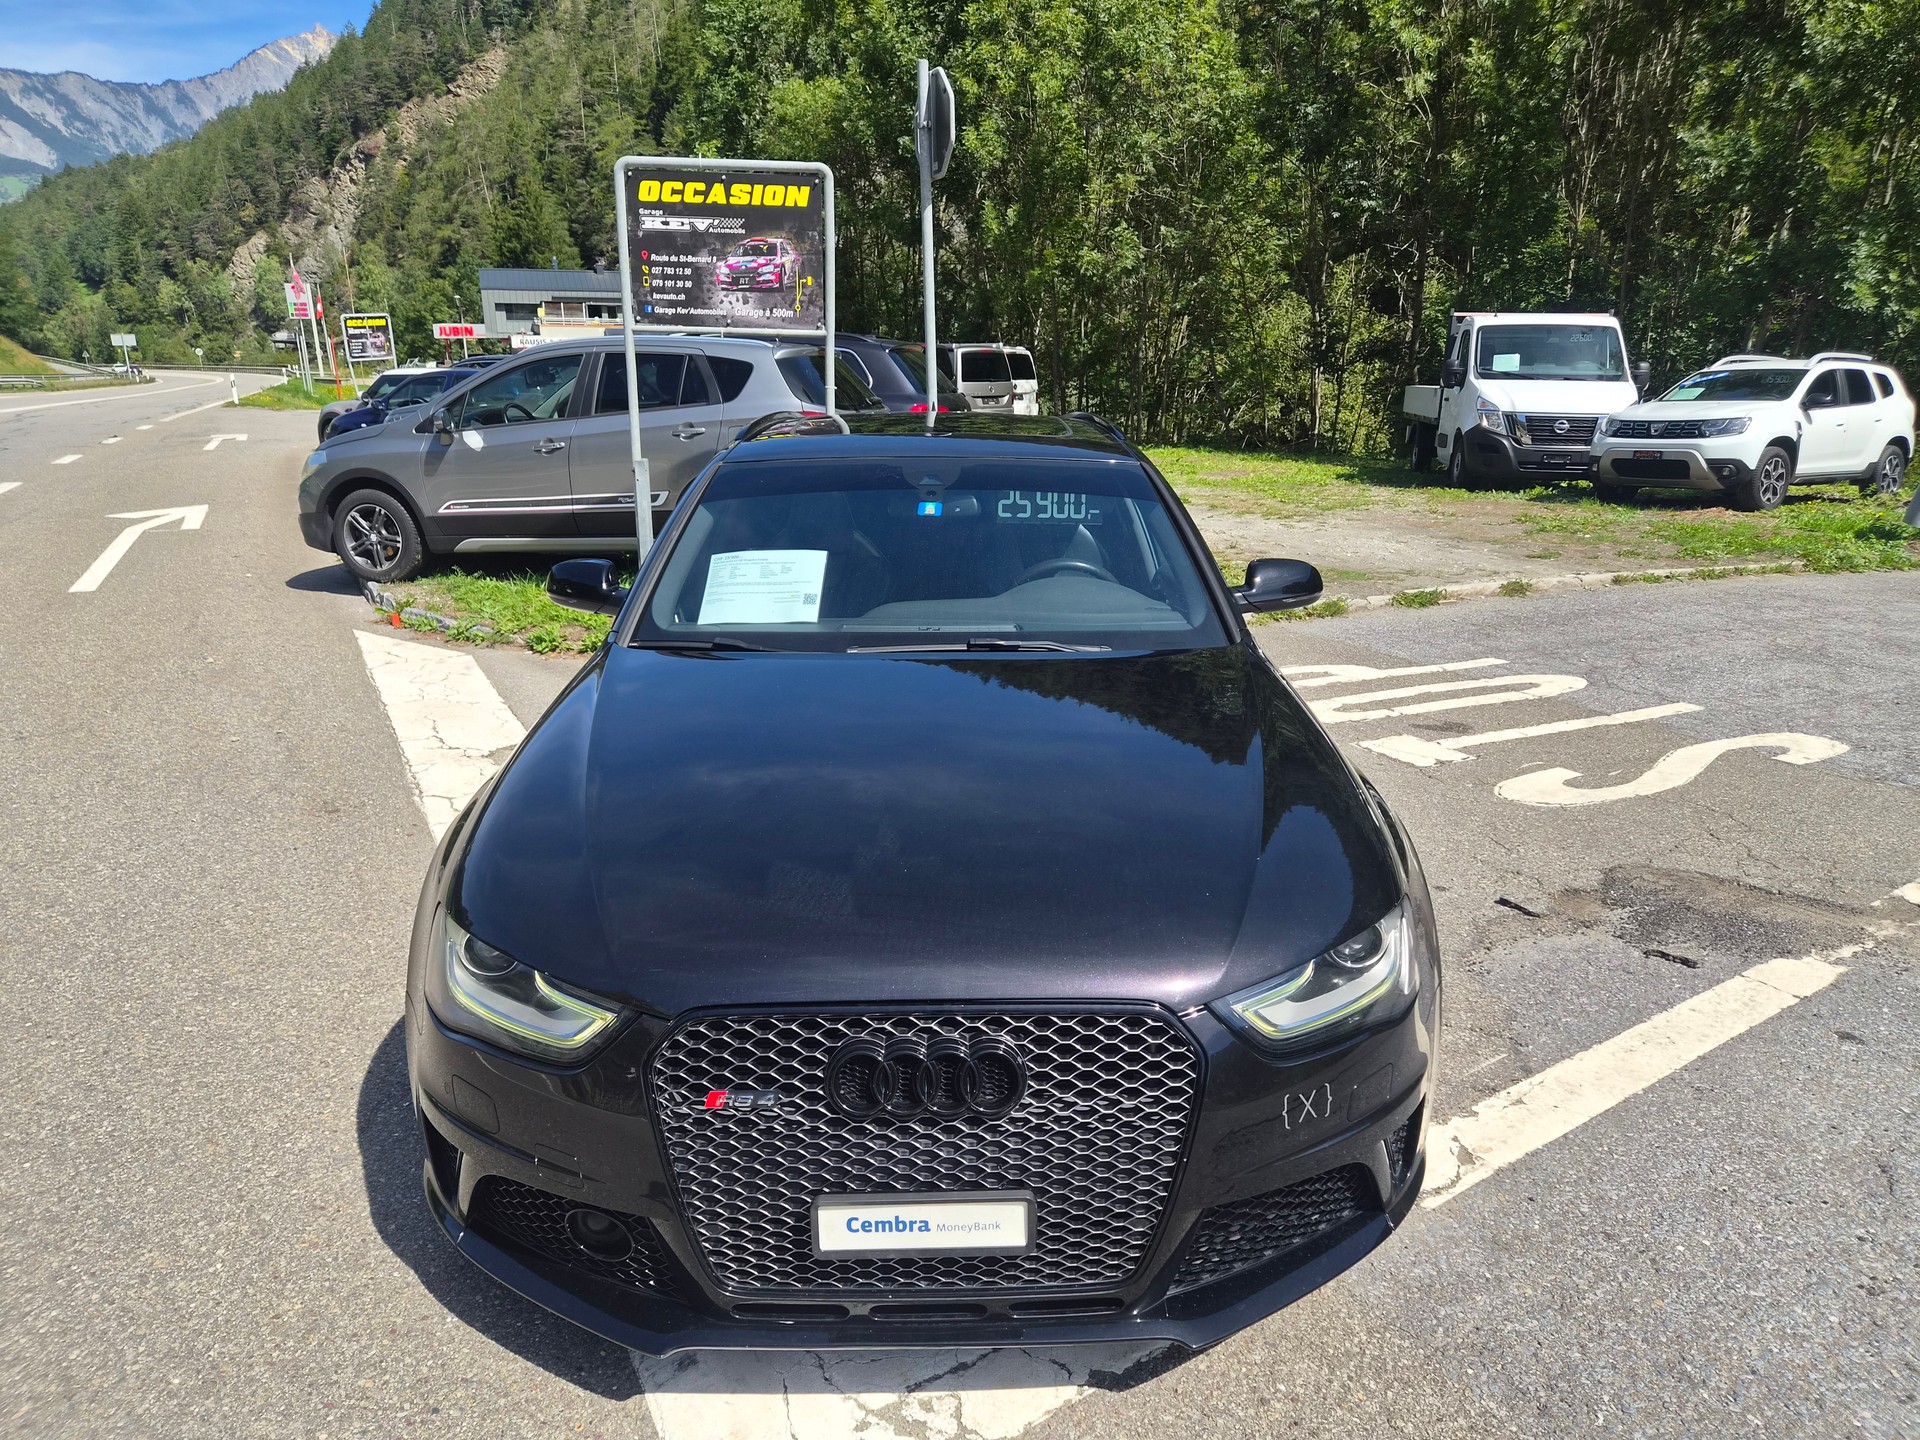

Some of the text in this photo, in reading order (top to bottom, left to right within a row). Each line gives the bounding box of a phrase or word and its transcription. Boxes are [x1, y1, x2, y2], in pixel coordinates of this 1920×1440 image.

[638, 180, 811, 207] OCCASION
[639, 208, 663, 216] Garage
[670, 254, 678, 262] du
[679, 254, 712, 263] St-Bernard
[653, 292, 686, 300] kevauto.ch
[654, 306, 676, 315] Garage
[735, 307, 794, 318] Garage à 500m
[346, 318, 387, 327] OCCASION
[439, 326, 474, 337] JUBIN
[846, 1215, 1001, 1234] Cembra MoneyBank
